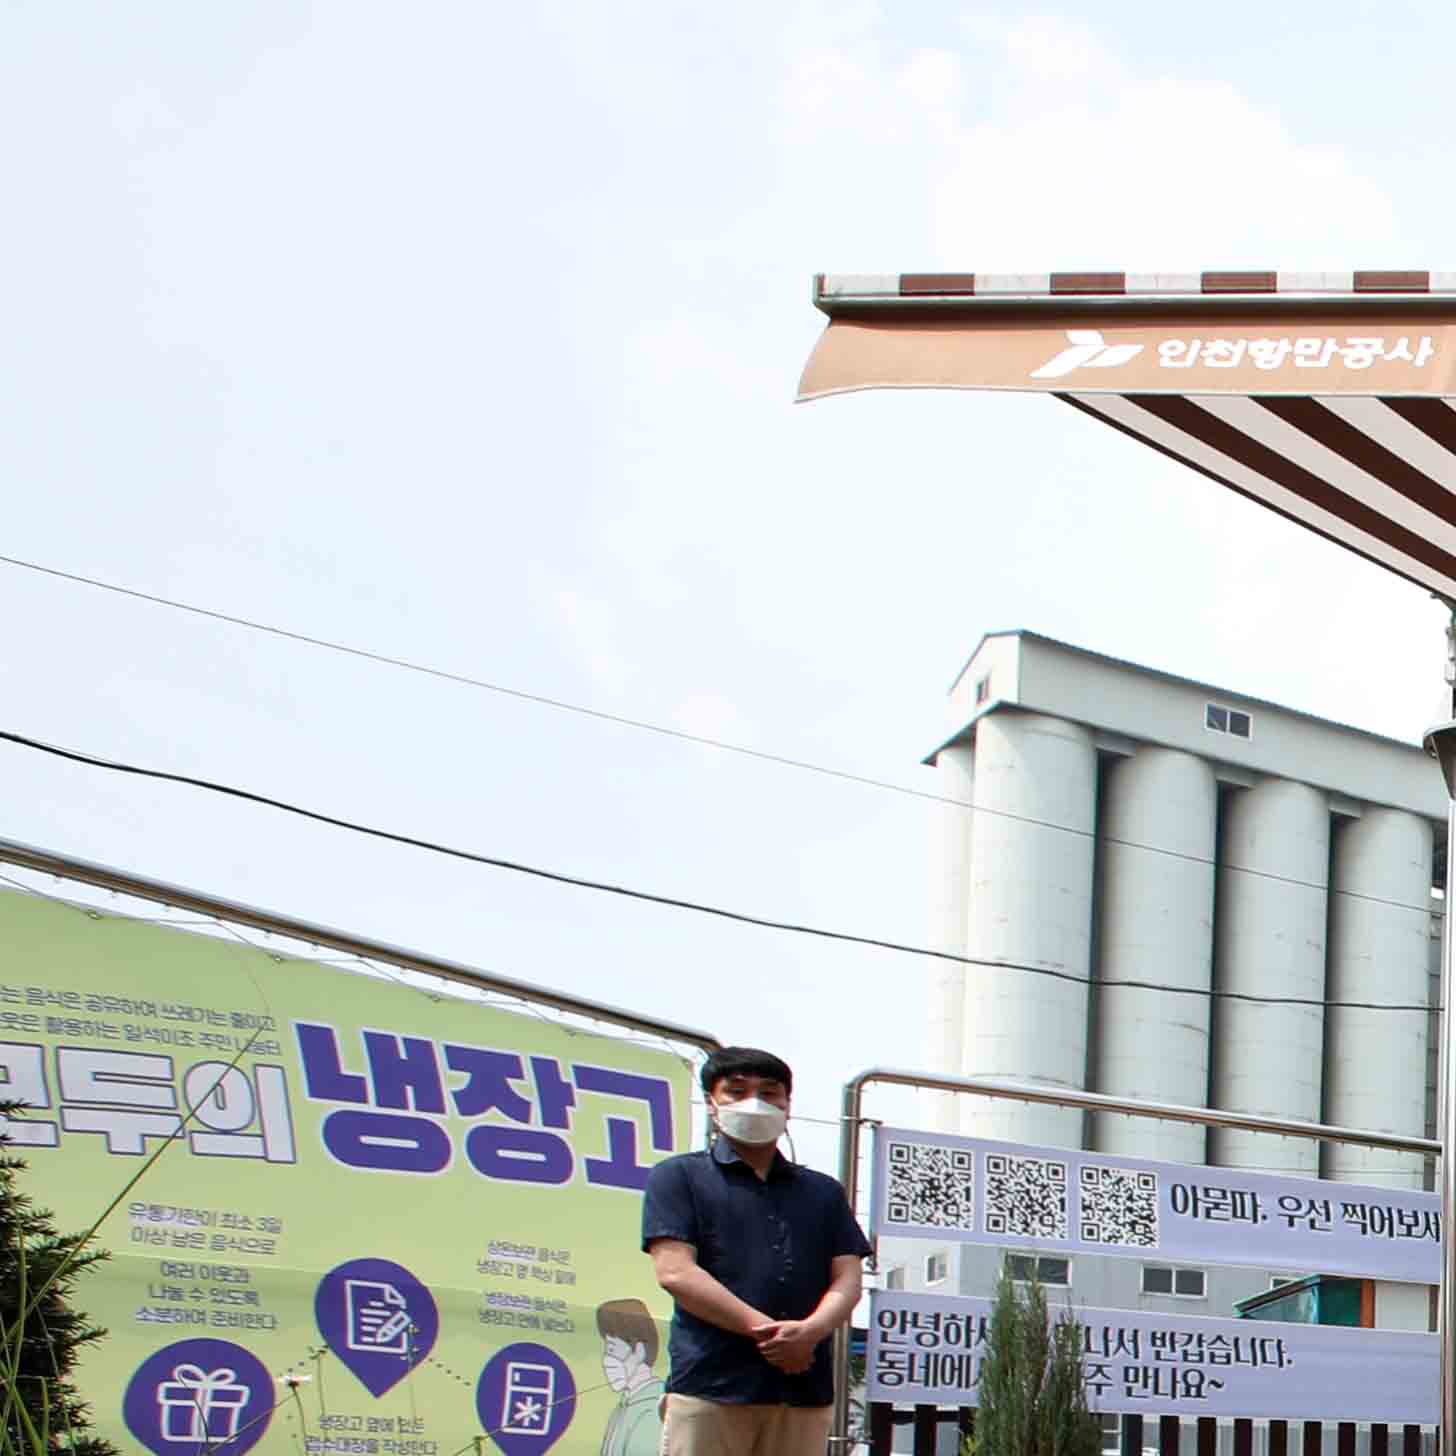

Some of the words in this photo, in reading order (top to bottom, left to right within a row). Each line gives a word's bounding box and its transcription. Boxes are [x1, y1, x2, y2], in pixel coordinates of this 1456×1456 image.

[1157, 337, 1436, 369] 인천항만공사
[85, 992, 157, 1019] 공유하여
[295, 1022, 675, 1192] 냉장고
[1278, 1196, 1334, 1232] 우선
[1151, 1331, 1292, 1369] 반갑습니다.
[876, 1350, 982, 1389] 동네에
